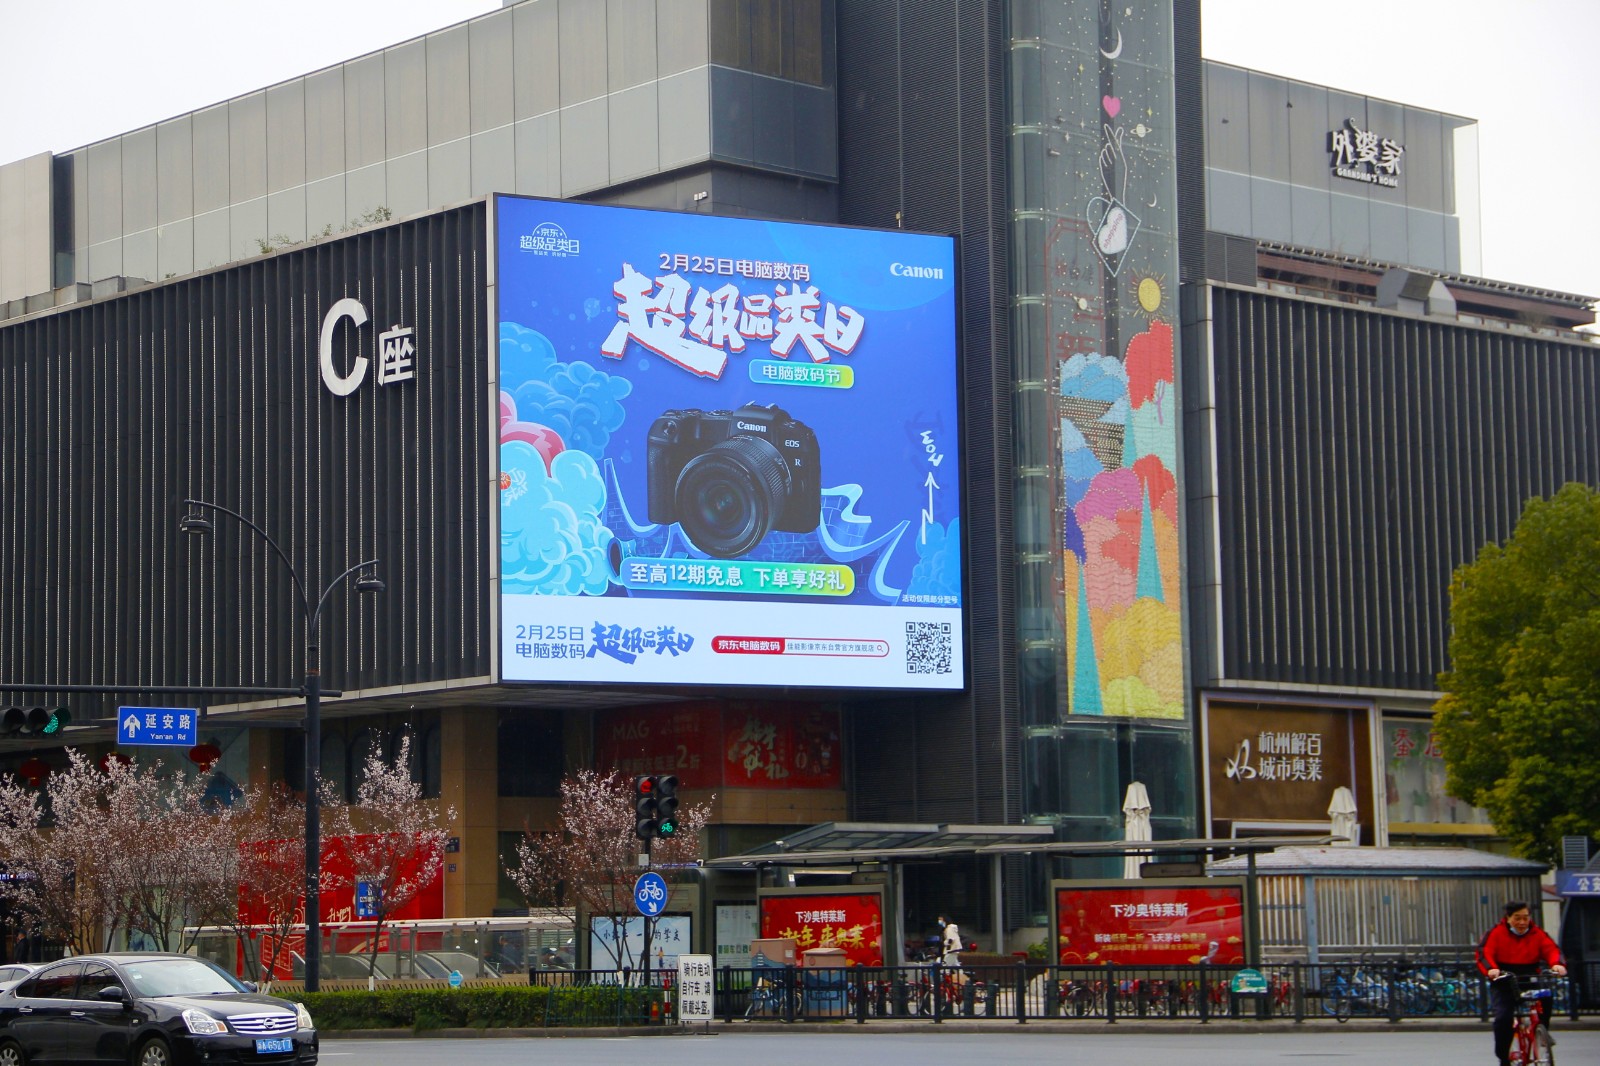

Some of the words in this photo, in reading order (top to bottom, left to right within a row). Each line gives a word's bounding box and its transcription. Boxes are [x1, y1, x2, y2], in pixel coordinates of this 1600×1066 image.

[1332, 117, 1404, 175] 外婆家
[1337, 167, 1377, 183] GRANDMA'S
[1378, 175, 1398, 187] HOME
[540, 228, 559, 238] 京东
[1103, 213, 1124, 249] shopping
[520, 235, 580, 254] 超级品类日
[659, 253, 811, 282] 2月25日电脑数码
[889, 262, 944, 280] Canon
[601, 262, 866, 381] 超级品类日
[762, 364, 841, 384] 电脑数码节
[736, 421, 767, 433] Canon
[785, 439, 800, 448] EOS
[795, 458, 802, 467] R
[630, 562, 744, 587] 至高12期免息
[753, 567, 846, 591] 下单享好礼
[515, 624, 585, 641] 2月25日
[515, 642, 586, 660] 电脑数码
[586, 620, 695, 665] 超级品类日
[718, 639, 781, 652] 京东电脑数码
[145, 713, 191, 730] 延安路
[1258, 731, 1322, 756] 杭州解百
[1258, 757, 1322, 782] 城市奥莱
[795, 909, 846, 923] 下沙奥特莱斯
[1110, 903, 1188, 918] 下沙奥特莱斯
[683, 962, 711, 977] 骑行电动
